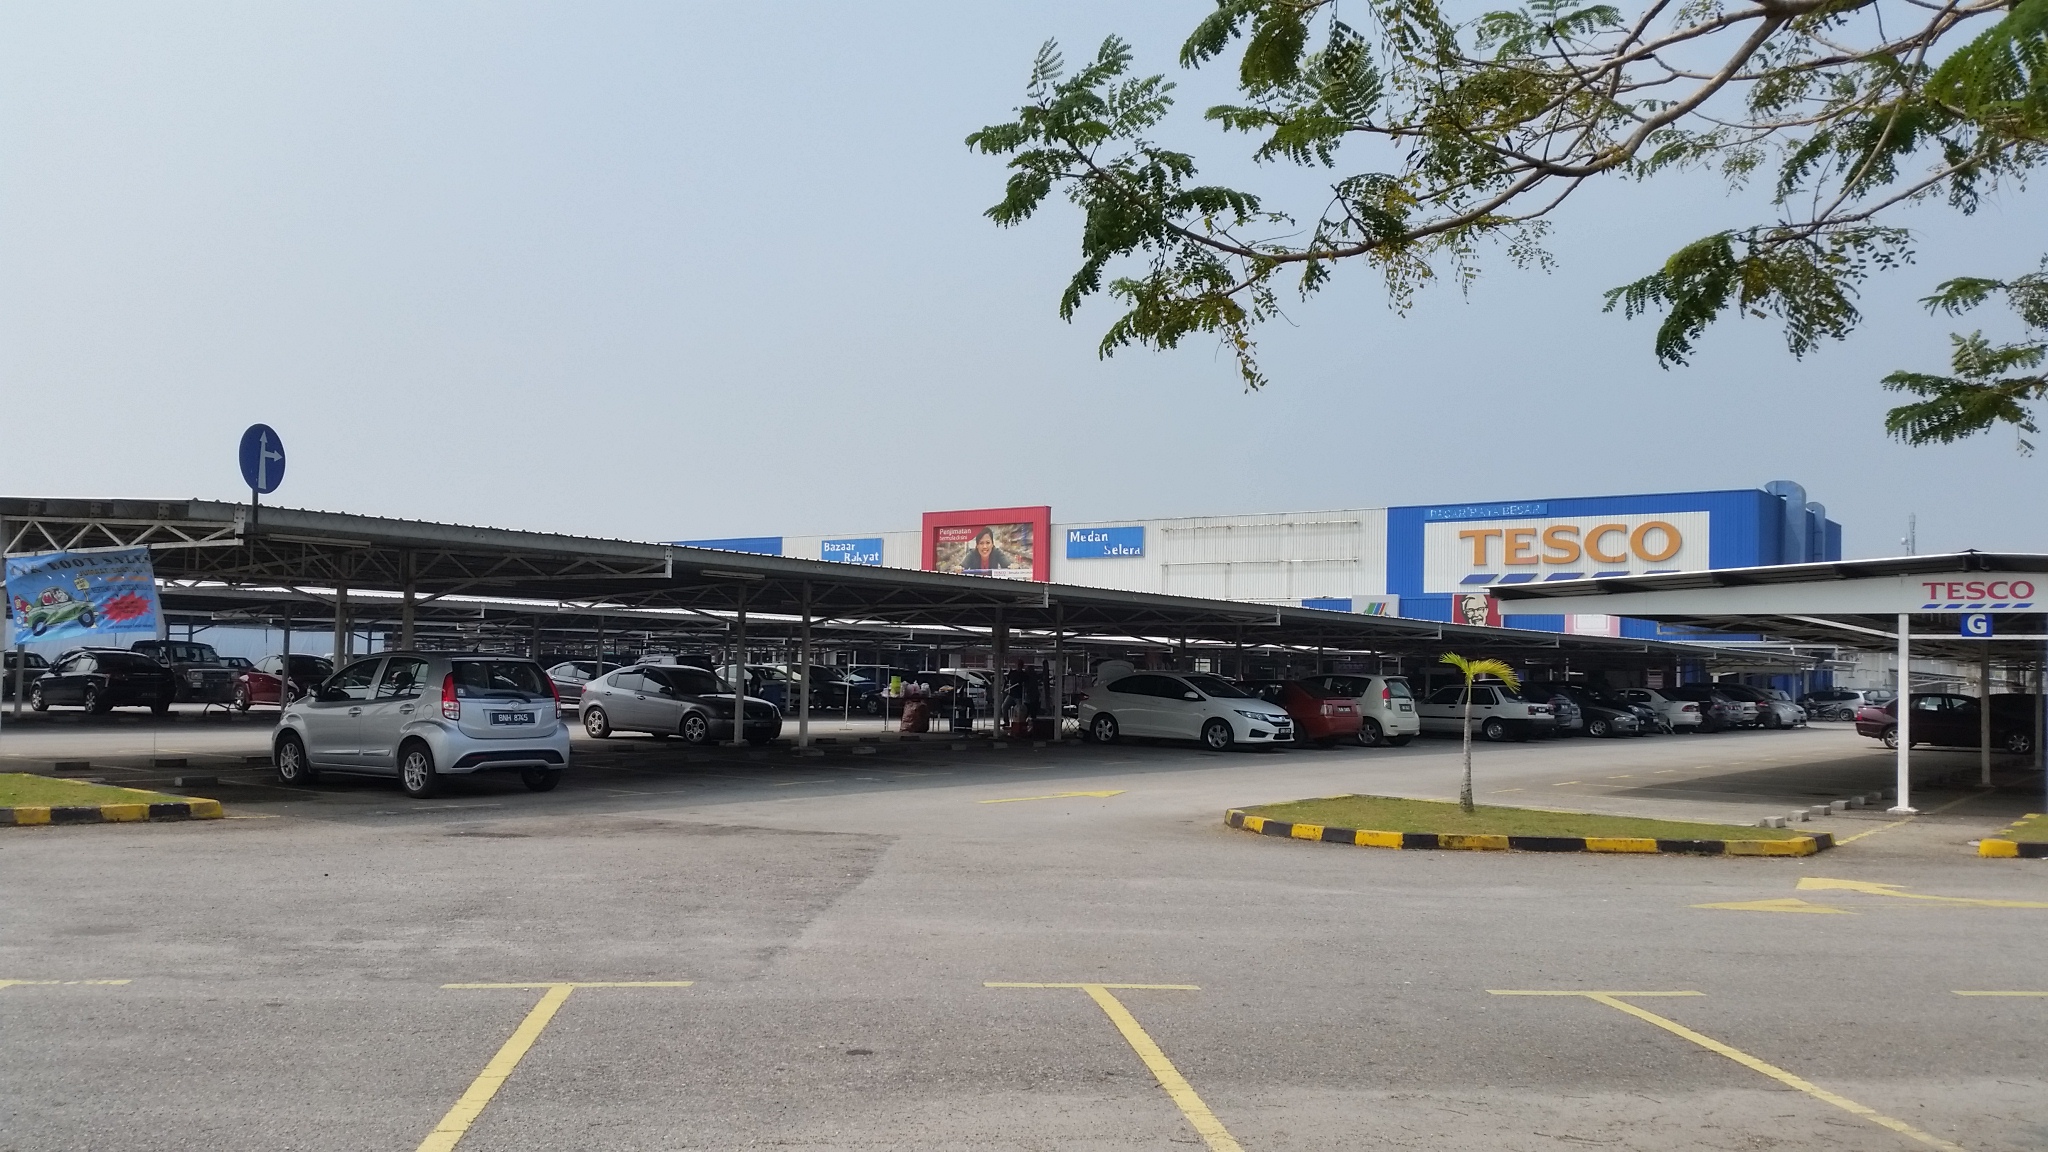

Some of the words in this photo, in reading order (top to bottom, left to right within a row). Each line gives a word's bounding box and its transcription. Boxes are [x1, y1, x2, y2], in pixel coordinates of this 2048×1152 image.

[1430, 509, 1467, 519] PASAR
[1469, 506, 1500, 517] RAYA
[1502, 504, 1540, 515] BESAR
[939, 528, 972, 536] Penjimatan
[1070, 530, 1109, 542] Medan
[824, 542, 856, 552] Bazaar
[1103, 543, 1141, 555] Selera
[1459, 520, 1682, 566] TESCO
[844, 552, 879, 563] Rakyat
[47, 557, 99, 571] BOOT
[1922, 581, 2035, 600] TESCO
[1967, 613, 1988, 634] G
[498, 714, 512, 722] BNH
